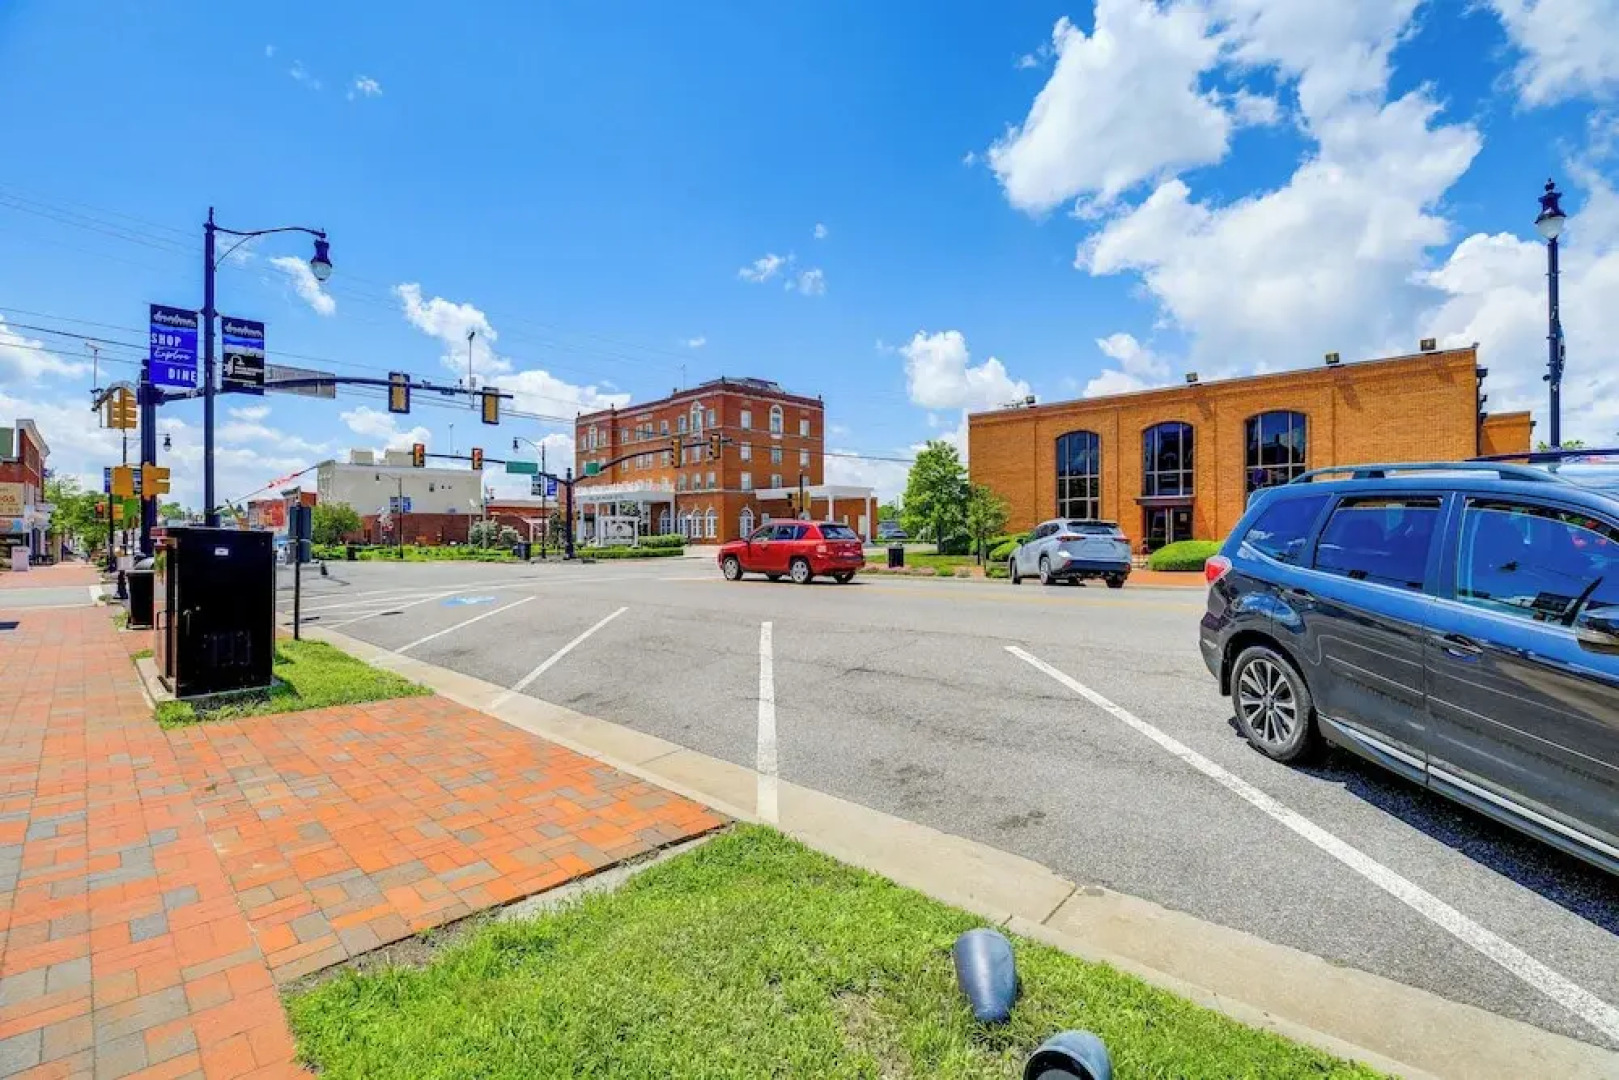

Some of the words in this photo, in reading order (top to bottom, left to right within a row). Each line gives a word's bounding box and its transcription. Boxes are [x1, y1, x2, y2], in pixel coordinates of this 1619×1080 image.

[151, 333, 181, 347] SHOP
[153, 348, 192, 362] Explore
[167, 367, 197, 383] DINE
